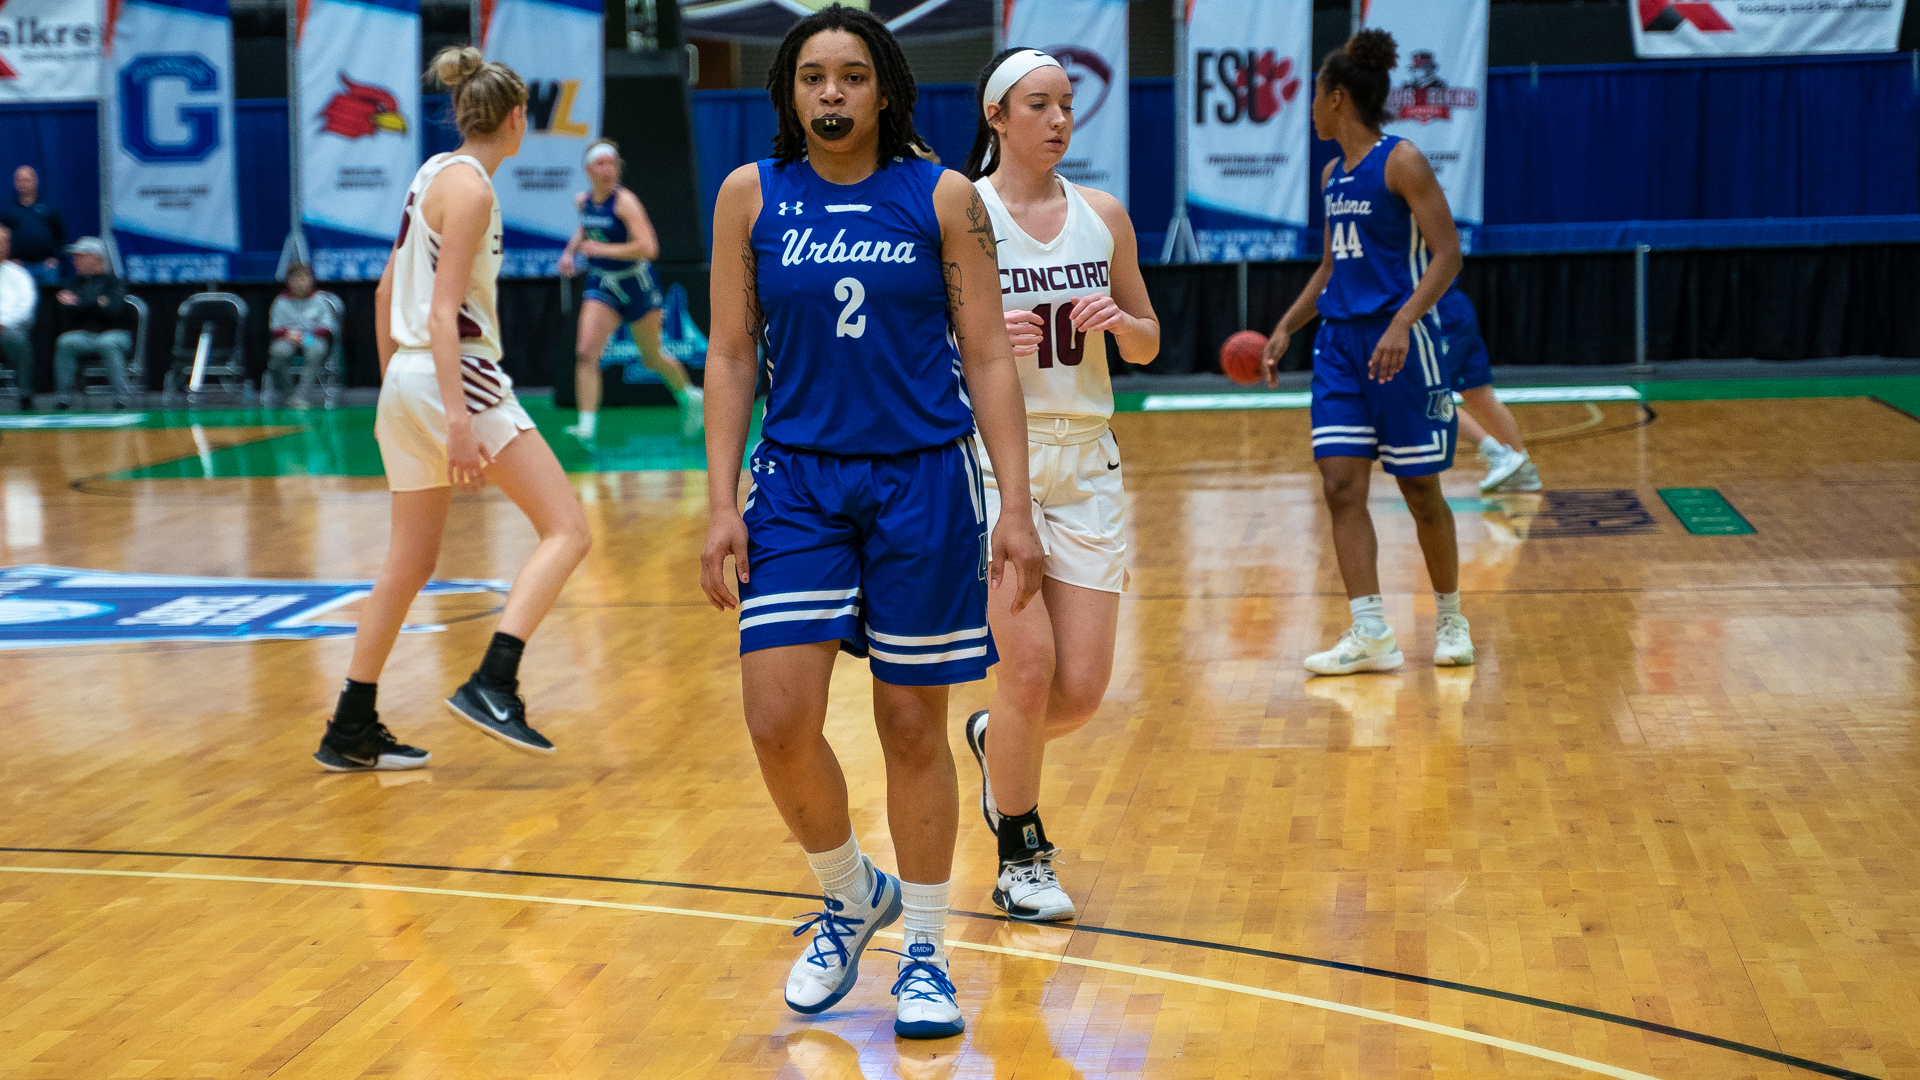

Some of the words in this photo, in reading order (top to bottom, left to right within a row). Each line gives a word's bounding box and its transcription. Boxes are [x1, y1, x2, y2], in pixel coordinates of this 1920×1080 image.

[118, 53, 220, 164] G
[781, 228, 917, 267] Urbana
[1332, 221, 1364, 260] 44
[999, 260, 1109, 294] CONCORD
[834, 277, 866, 339] 2
[1031, 301, 1088, 369] 10
